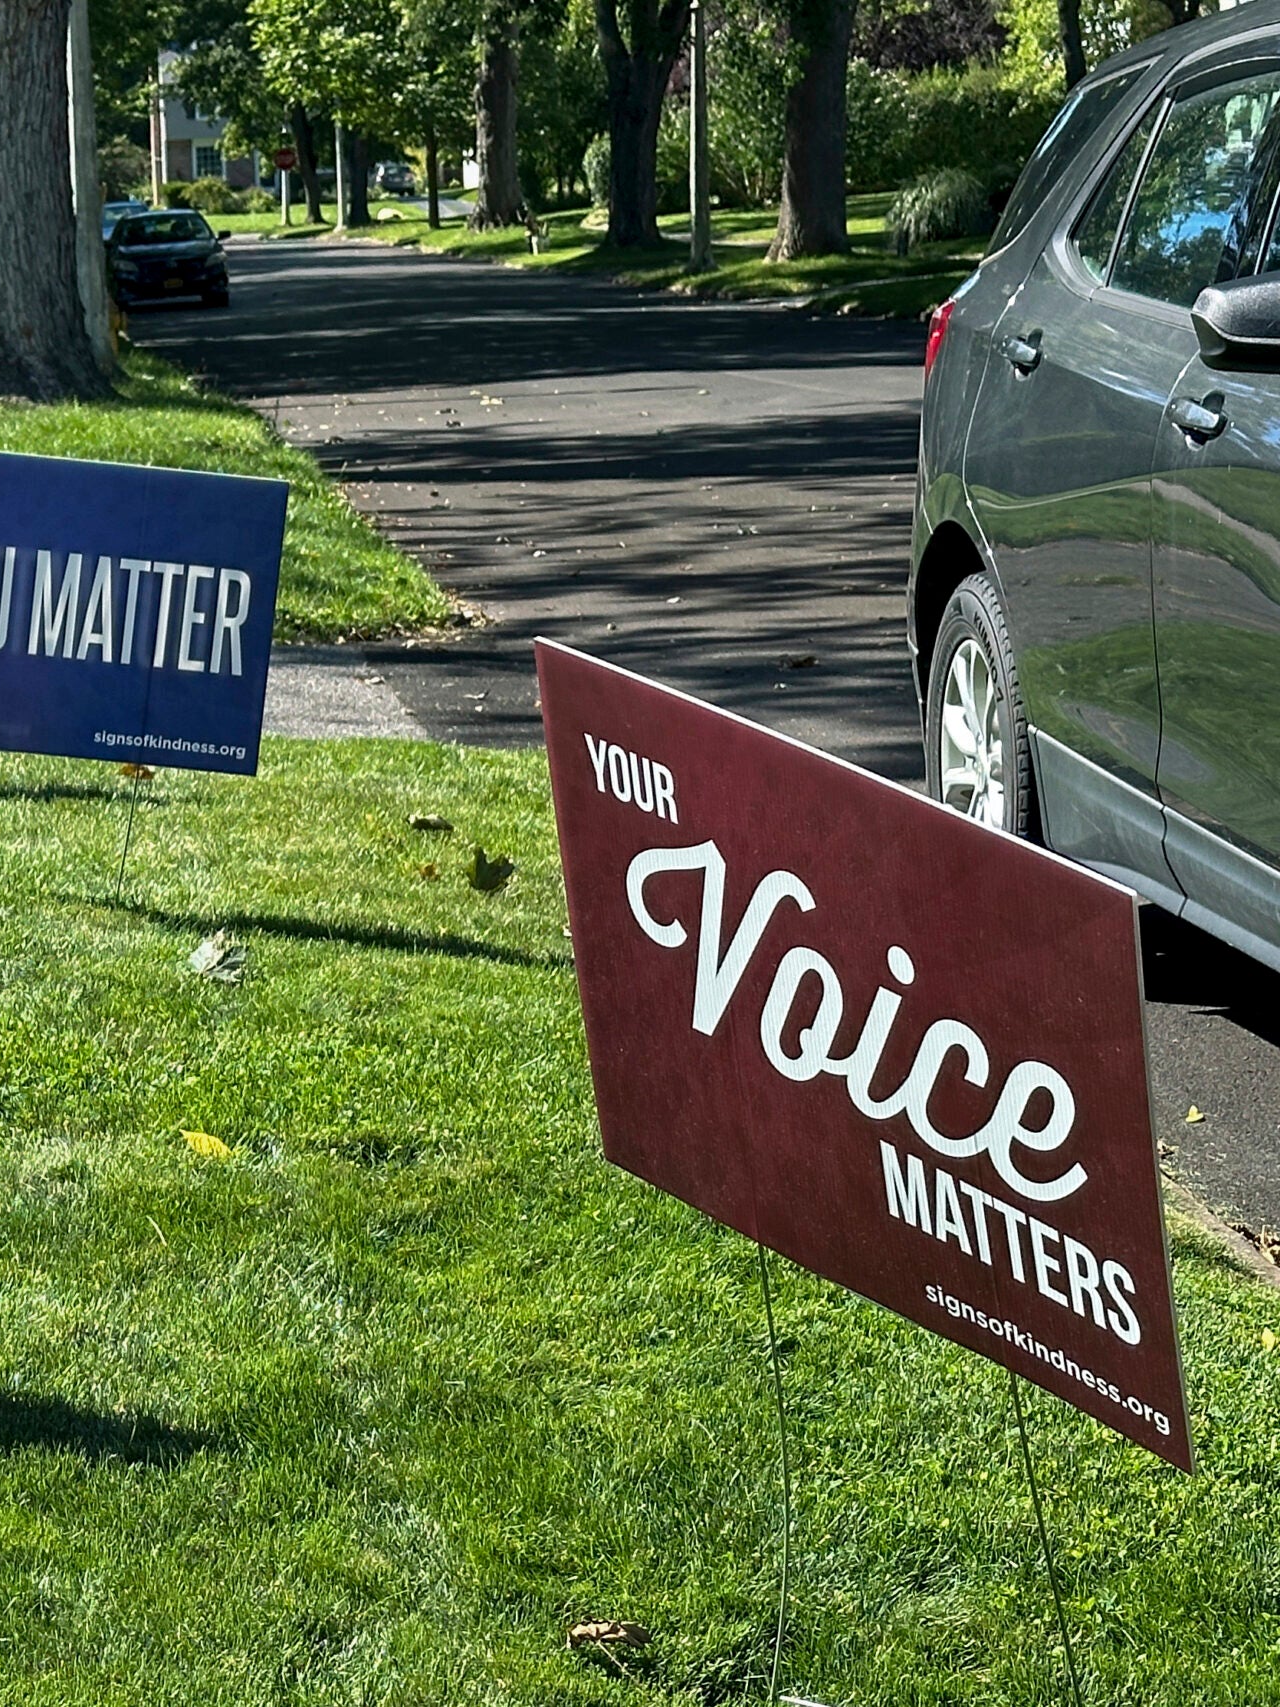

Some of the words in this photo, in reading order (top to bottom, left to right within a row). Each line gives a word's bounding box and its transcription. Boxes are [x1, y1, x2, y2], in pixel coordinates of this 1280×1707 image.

[27, 549, 251, 677] MATTER
[93, 730, 247, 760] signsofkindness.org
[583, 732, 679, 825] YOUR
[626, 839, 1089, 1202] Voice
[879, 1139, 1141, 1346] MATTERS
[925, 1284, 1171, 1437] signsofkindness.org
